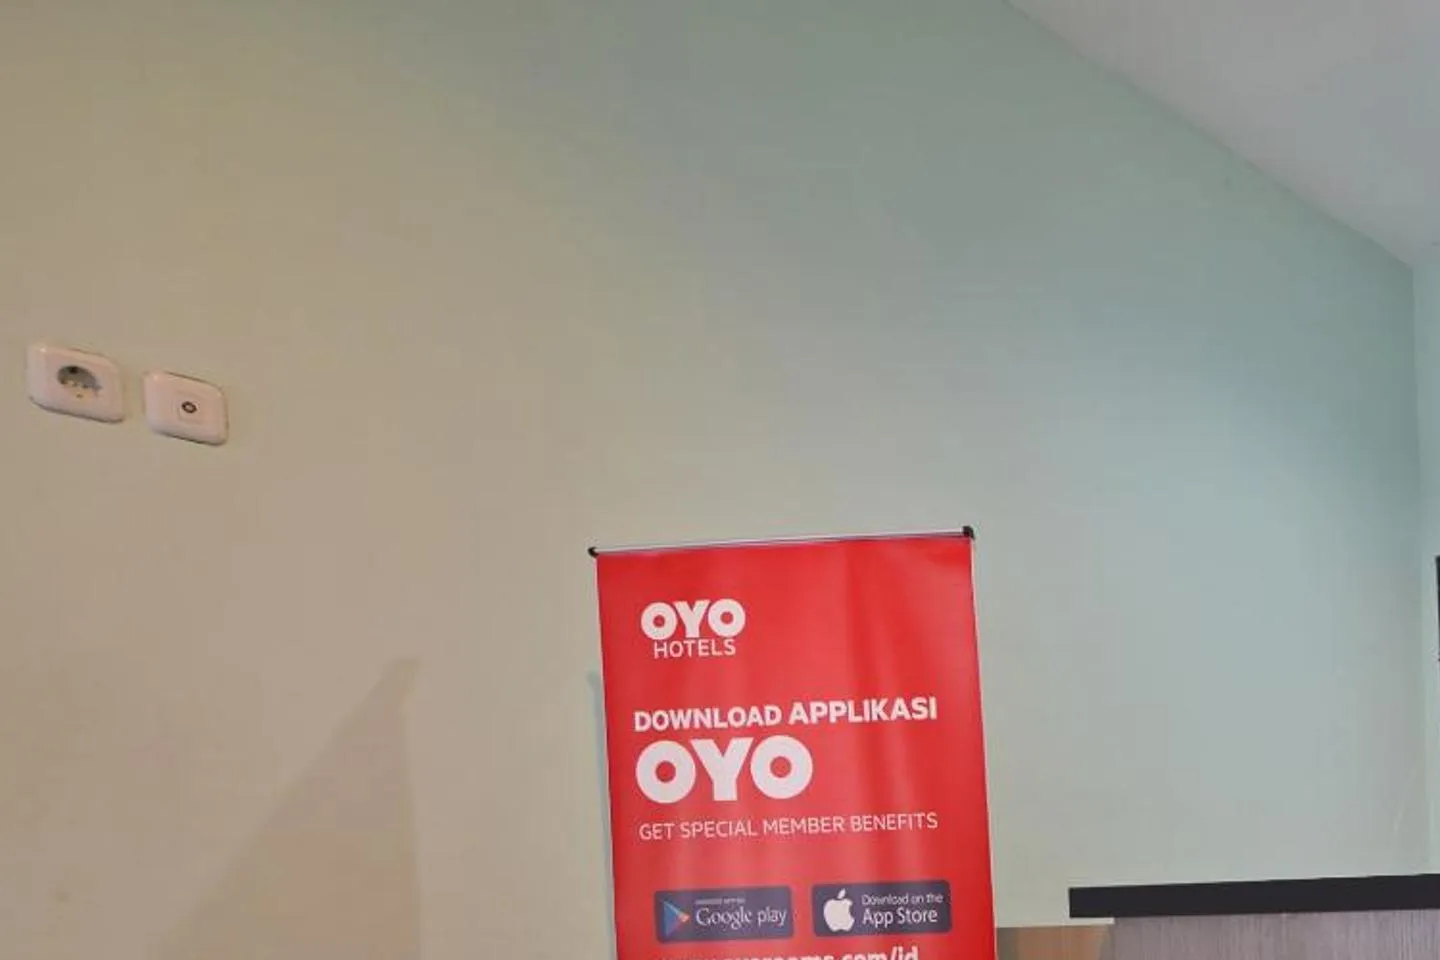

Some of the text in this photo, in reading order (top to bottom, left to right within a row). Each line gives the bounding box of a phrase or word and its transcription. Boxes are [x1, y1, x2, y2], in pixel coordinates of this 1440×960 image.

[641, 598, 746, 641] OYO
[653, 638, 737, 659] HOTELS
[634, 697, 938, 732] DOWNLOAD APPLIKASI
[635, 734, 814, 804] OYO
[639, 811, 938, 841] GET SPECIAL MEMBER BENEFITS
[862, 892, 944, 906] Download on the
[696, 905, 787, 930] Google play
[862, 905, 938, 928] App Store
